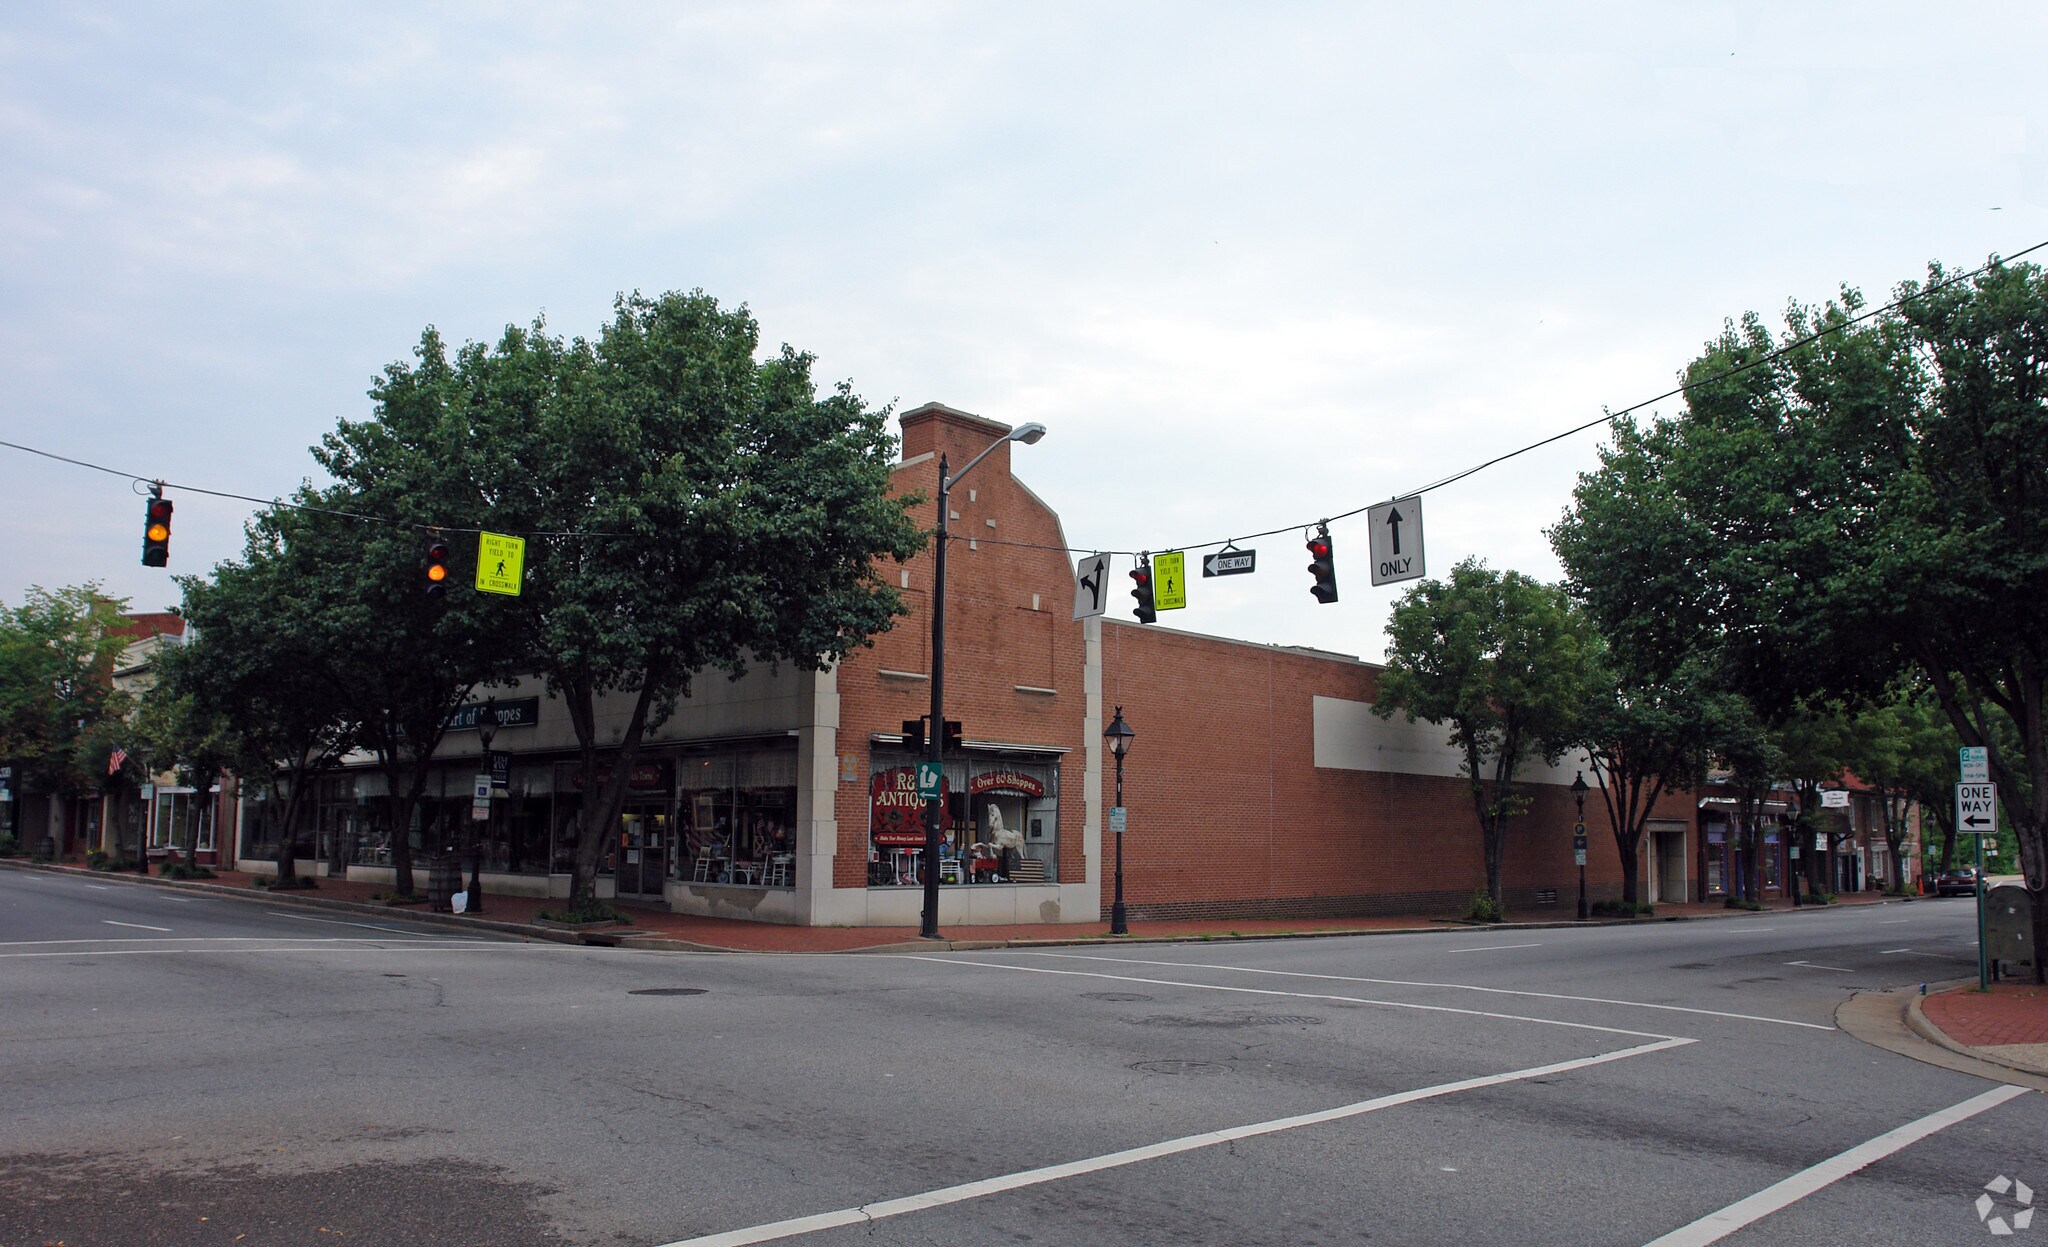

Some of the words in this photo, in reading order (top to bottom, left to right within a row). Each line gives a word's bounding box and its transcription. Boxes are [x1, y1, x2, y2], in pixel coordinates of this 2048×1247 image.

[486, 538, 501, 547] RIGHT
[505, 541, 518, 550] TURN
[489, 548, 503, 557] YIELD
[508, 551, 514, 559] TO
[1158, 558, 1167, 566] LEFT
[1217, 559, 1232, 570] ONE
[1234, 557, 1250, 567] WAY
[1380, 557, 1412, 577] ONLY
[1160, 567, 1171, 575] YIELD
[489, 579, 517, 590] CROSSWALK
[1163, 596, 1184, 606] CROSSWALK
[466, 707, 477, 725] of
[1963, 750, 1969, 760] 2
[977, 777, 994, 788] Over
[996, 774, 1005, 784] 60
[1006, 774, 1036, 790] Shoppes
[1961, 787, 1990, 798] ONE
[876, 790, 944, 810] ANTIQUS
[1961, 801, 1991, 812] WAY
